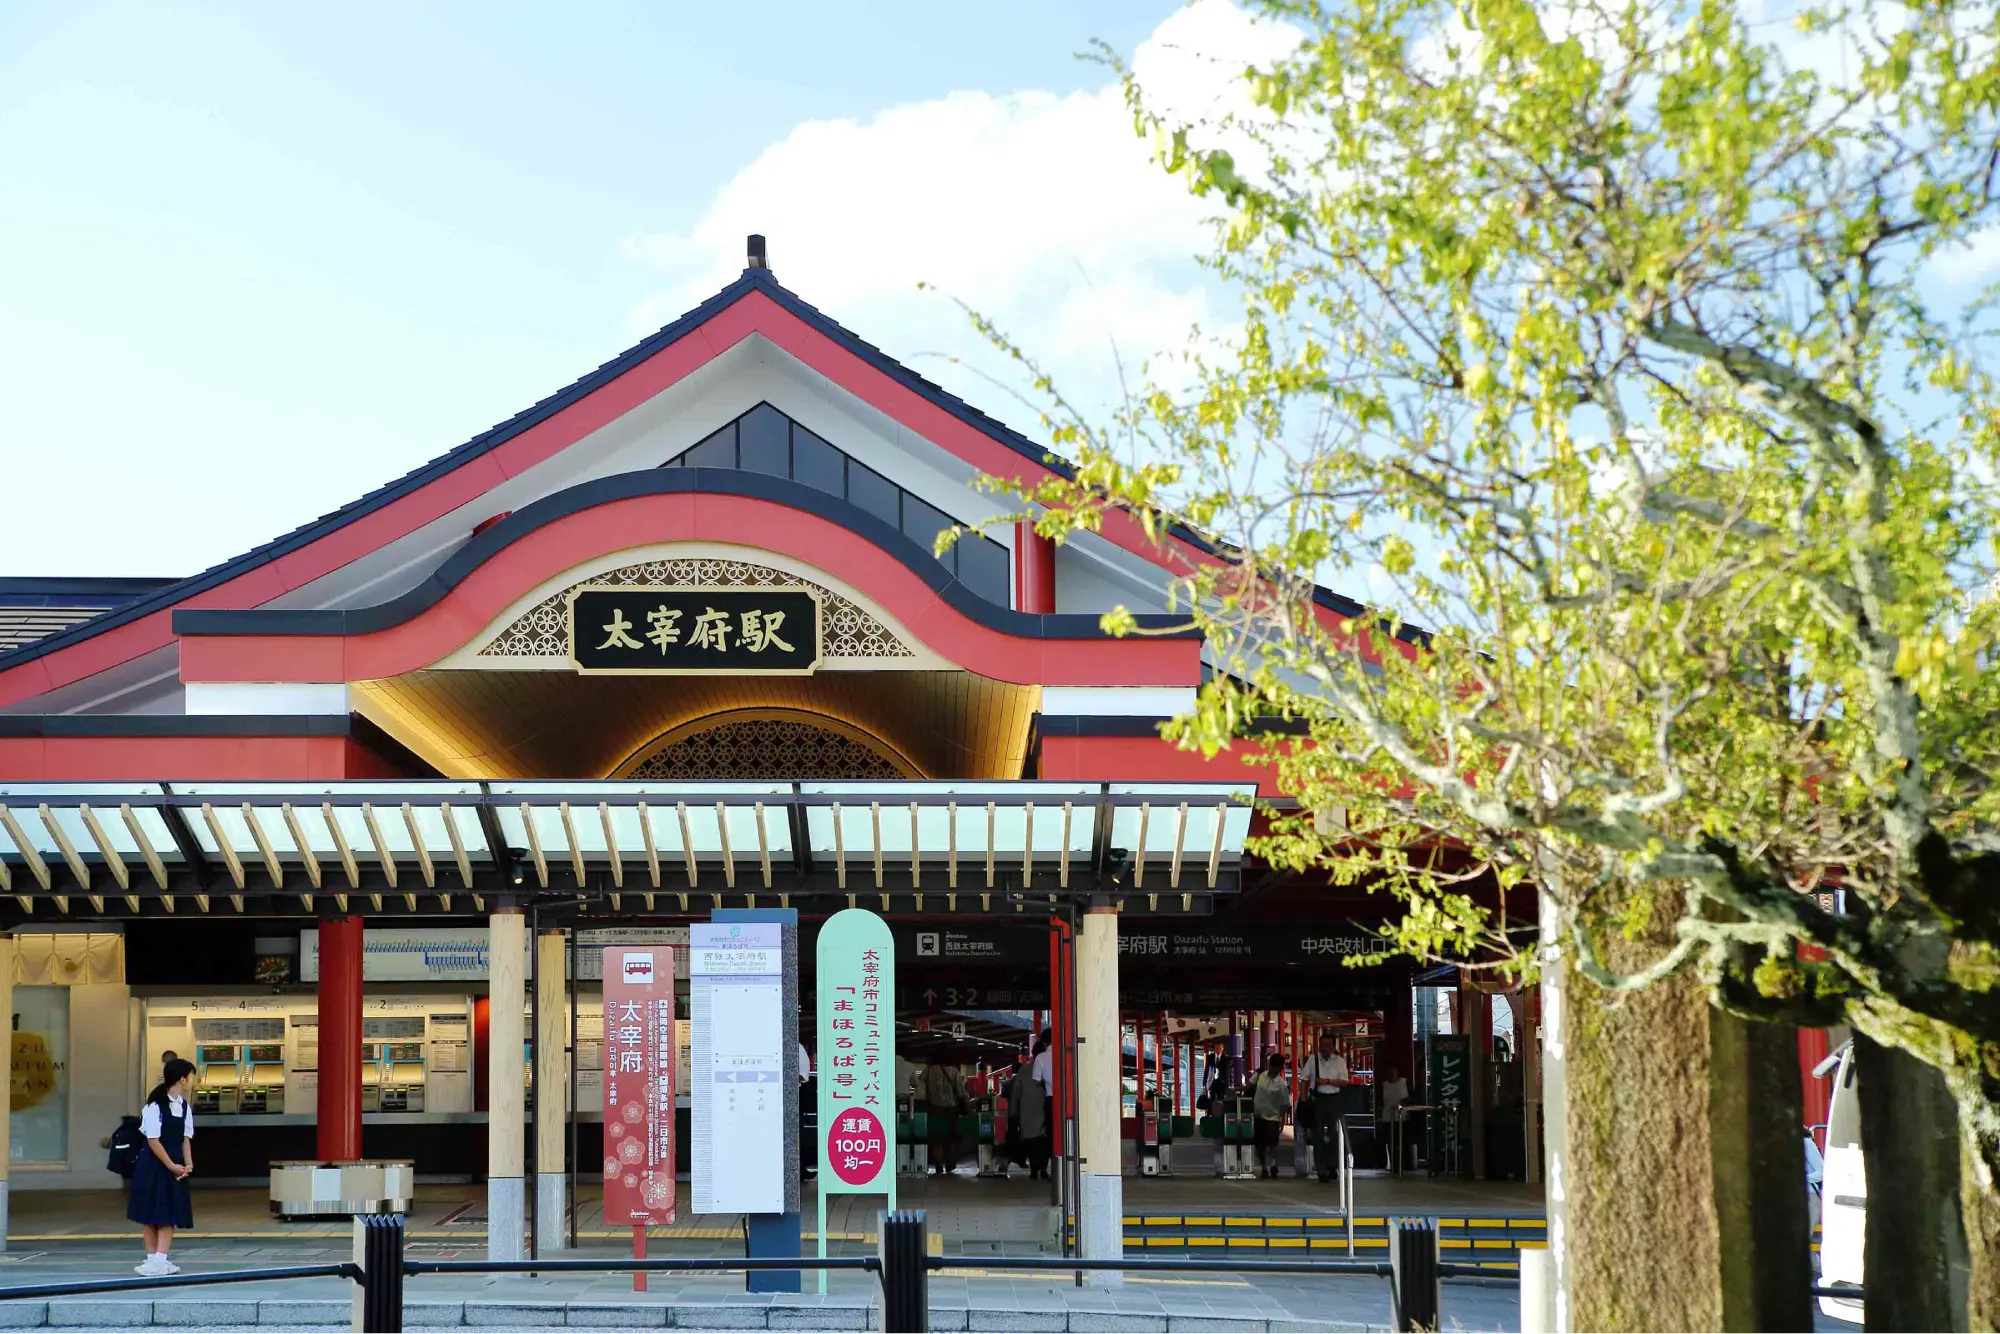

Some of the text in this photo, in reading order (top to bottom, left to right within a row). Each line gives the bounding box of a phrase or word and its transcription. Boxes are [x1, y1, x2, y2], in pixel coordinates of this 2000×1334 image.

[595, 604, 796, 656] 太宰府駅
[1173, 935, 1243, 944] Dazaifu Station
[1301, 937, 1386, 954] 中央改札口
[192, 1001, 198, 1011] 5
[239, 1001, 246, 1010] 4
[380, 1000, 386, 1009] 2
[609, 1001, 617, 1041] Dazaifu
[862, 949, 880, 1105] 太宰府市コミュニティバス
[1358, 1022, 1366, 1033] 2
[620, 999, 643, 1073] 太宰府
[954, 1025, 963, 1035] 4
[832, 986, 857, 1099] 「まほろば号」
[842, 1118, 872, 1133] 運賃
[835, 1138, 881, 1153] 100円
[844, 1155, 874, 1170] 均一
